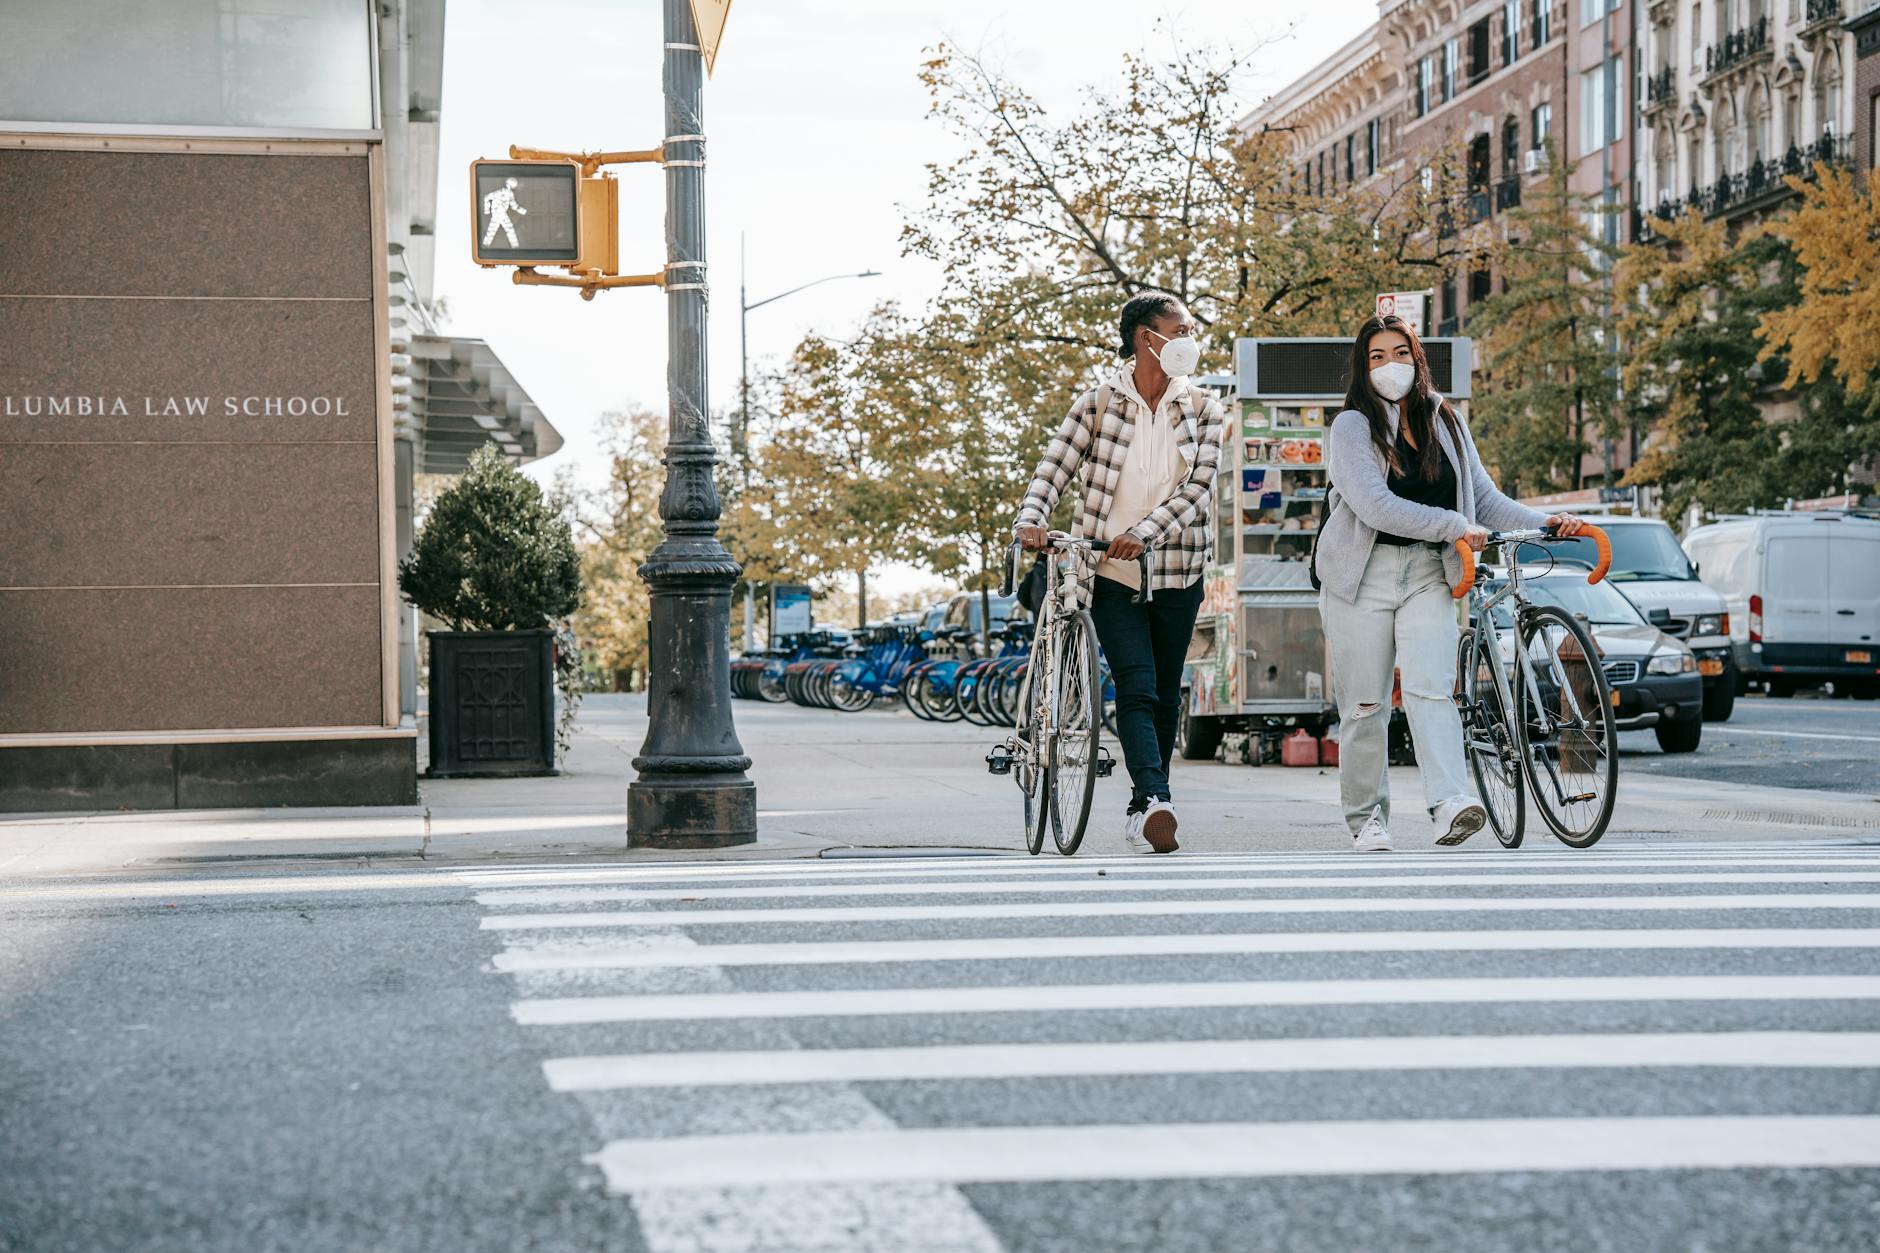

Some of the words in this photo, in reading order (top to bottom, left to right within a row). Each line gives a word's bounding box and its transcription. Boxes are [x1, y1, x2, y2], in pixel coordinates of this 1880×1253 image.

[5, 396, 129, 416] LUMBIA
[144, 396, 209, 416] LAW
[224, 396, 349, 416] SCHOOL
